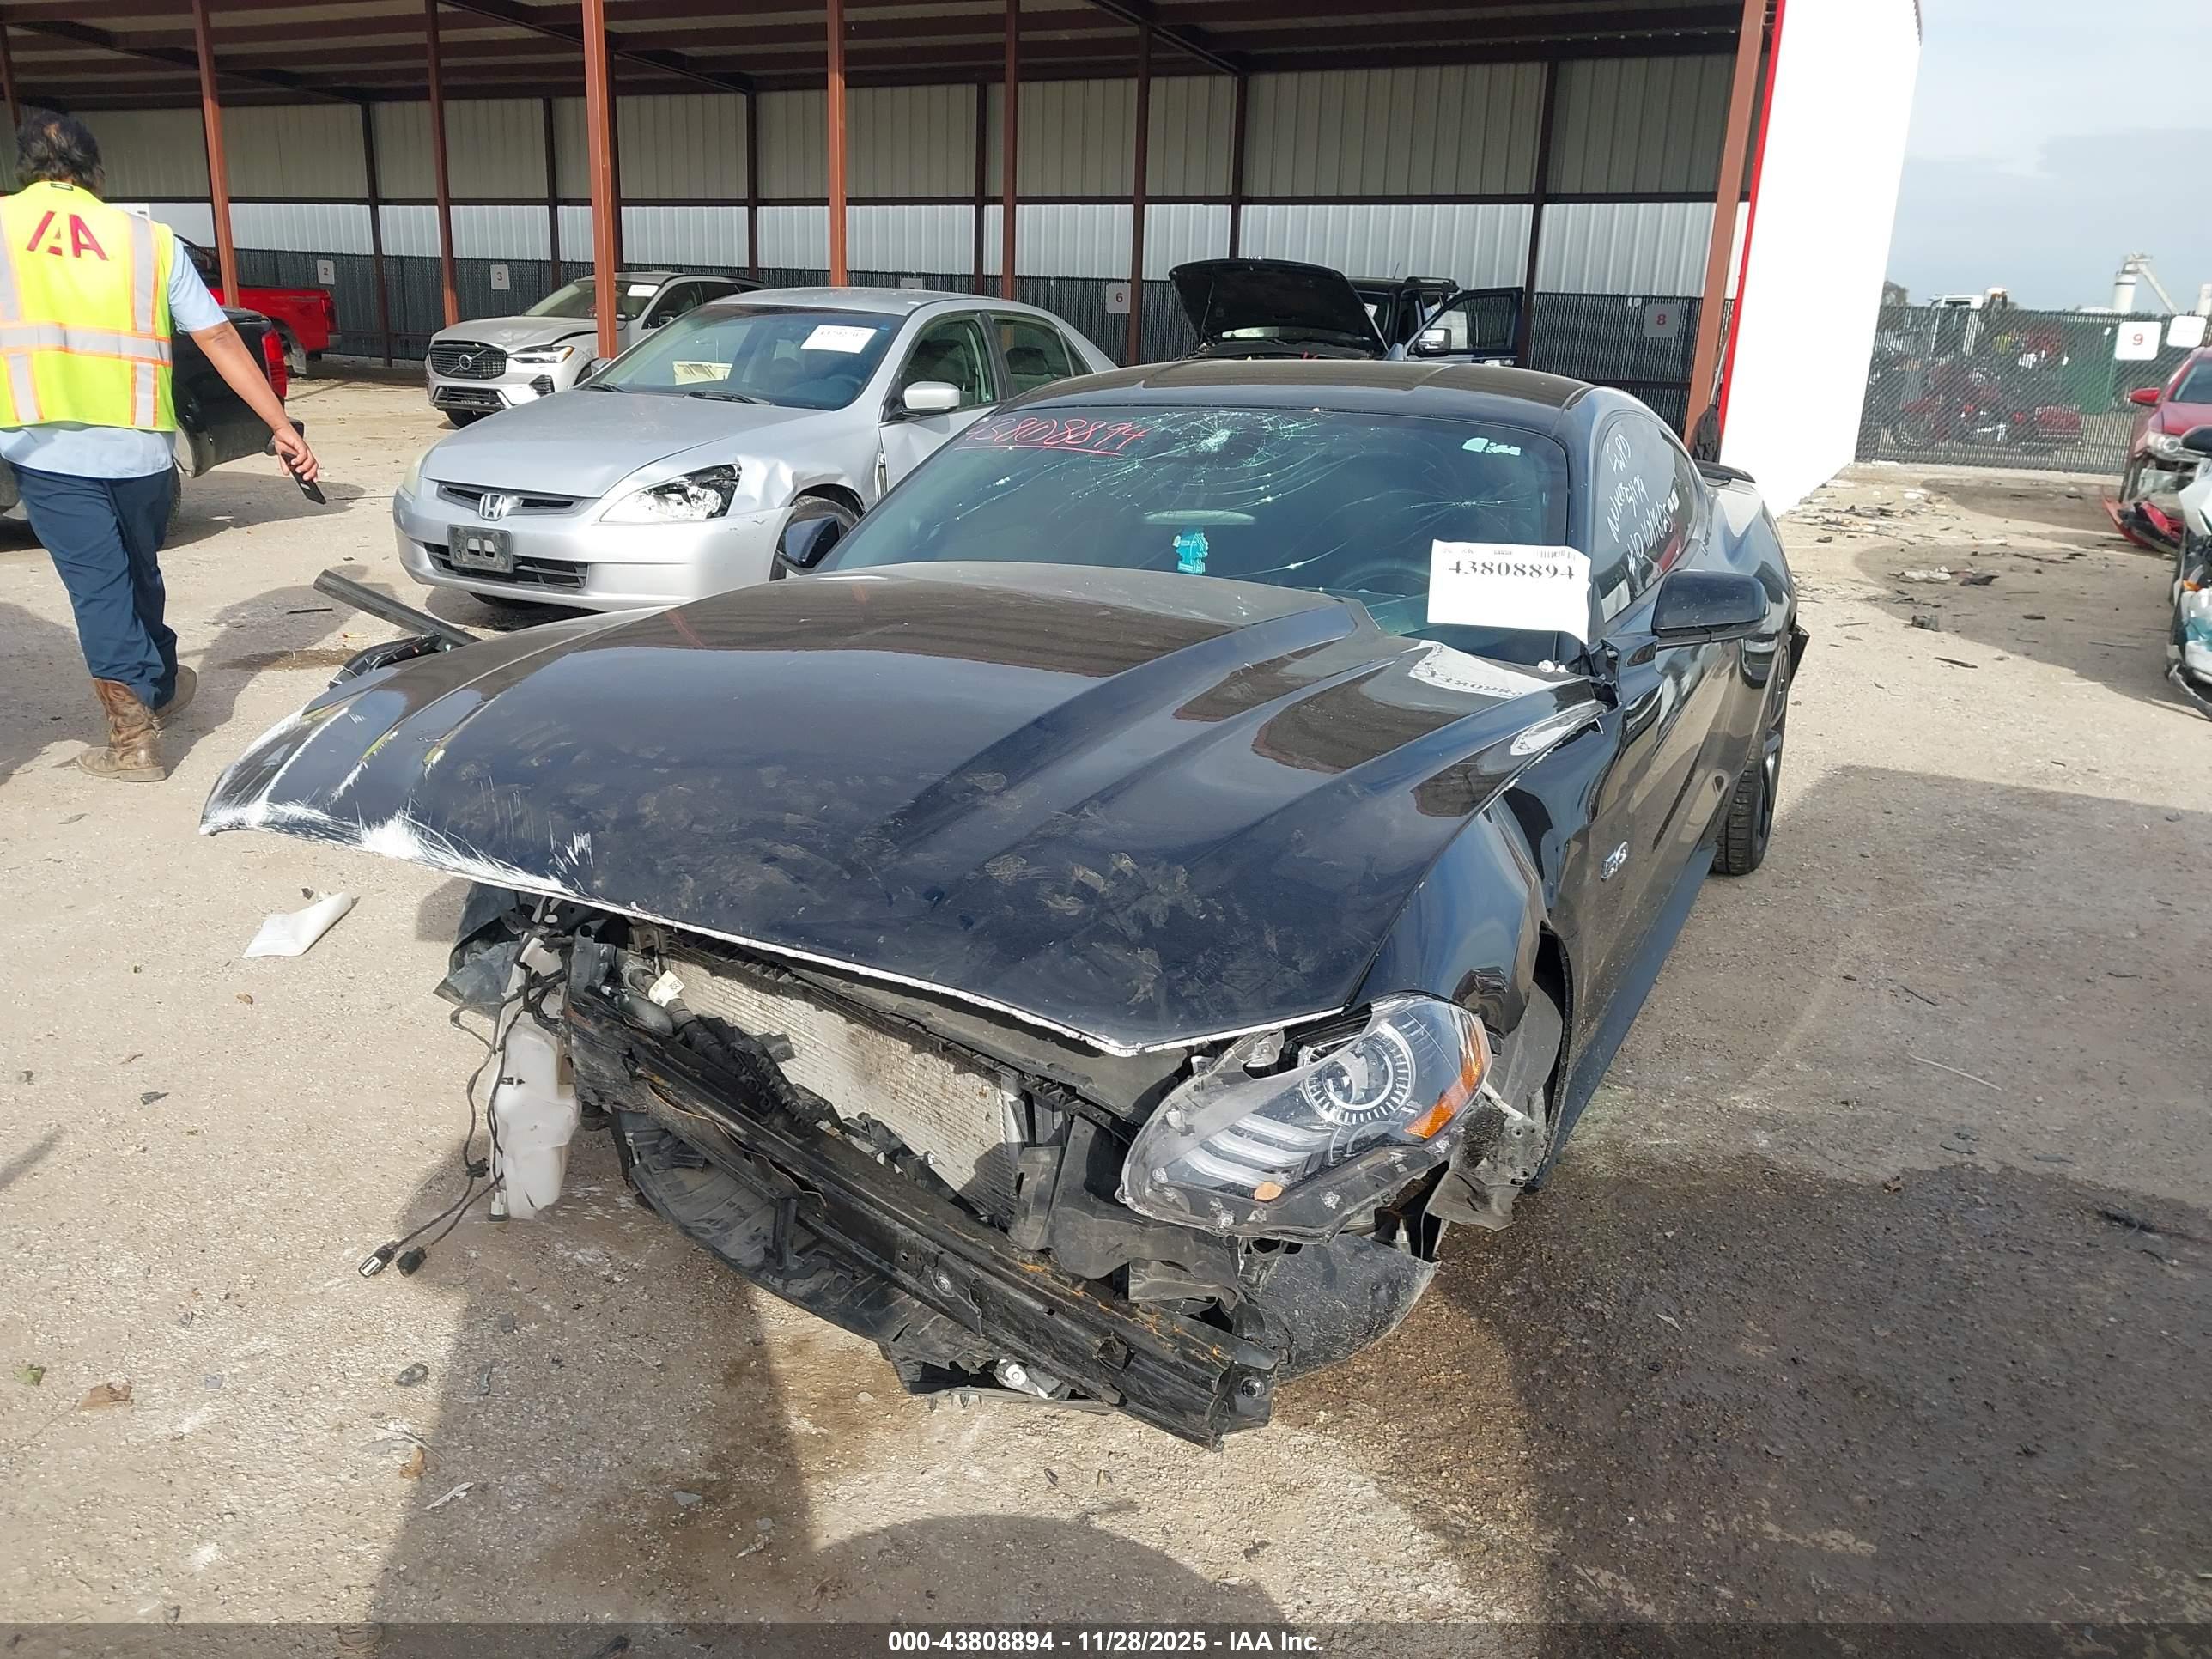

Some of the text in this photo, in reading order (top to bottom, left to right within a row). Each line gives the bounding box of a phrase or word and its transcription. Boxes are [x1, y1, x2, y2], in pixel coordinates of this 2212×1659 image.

[323, 267, 329, 276] 2
[496, 271, 503, 281] 3
[1115, 292, 1123, 302] 6
[1656, 314, 1666, 325] 8
[2132, 333, 2143, 346] 9
[1448, 560, 1575, 580] 43808894
